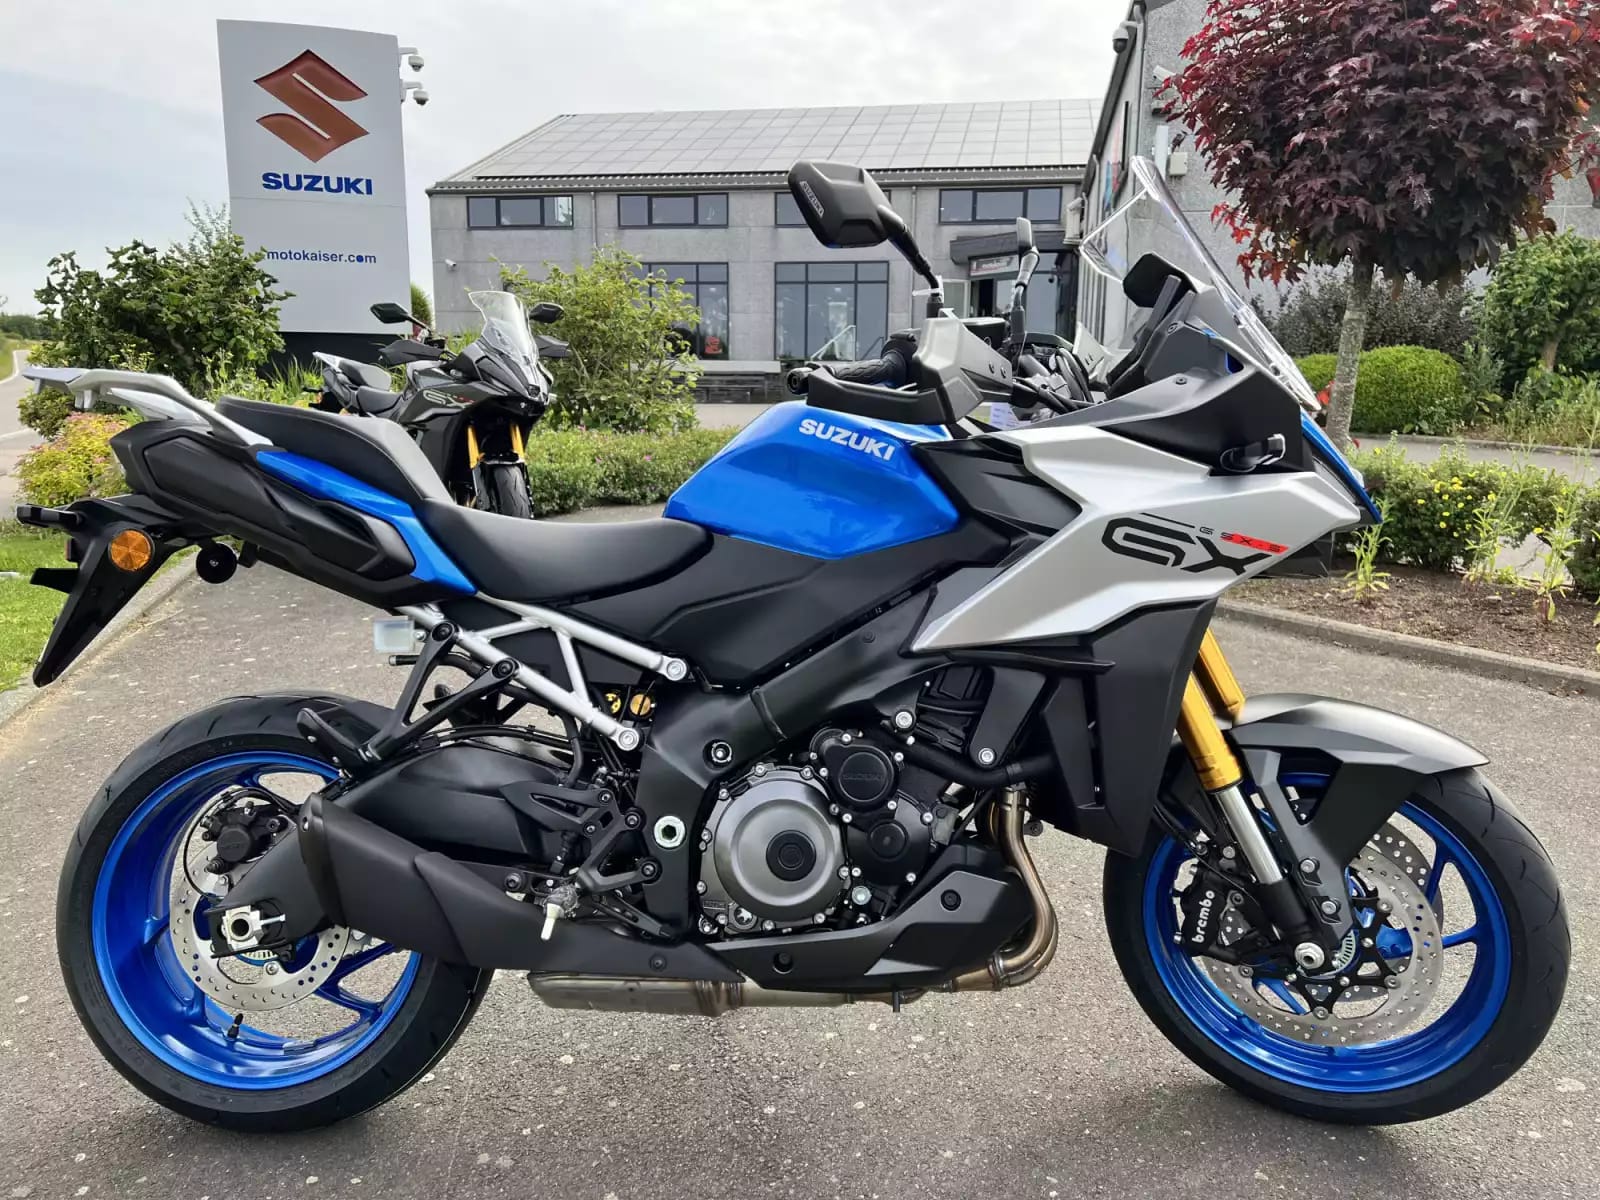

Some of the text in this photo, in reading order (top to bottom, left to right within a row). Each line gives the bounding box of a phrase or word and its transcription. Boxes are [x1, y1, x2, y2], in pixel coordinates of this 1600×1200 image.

[262, 172, 372, 195] SUZUKI
[266, 249, 377, 264] motokaiser.com
[799, 419, 896, 461] SUZUKI
[1191, 890, 1216, 943] brembo
